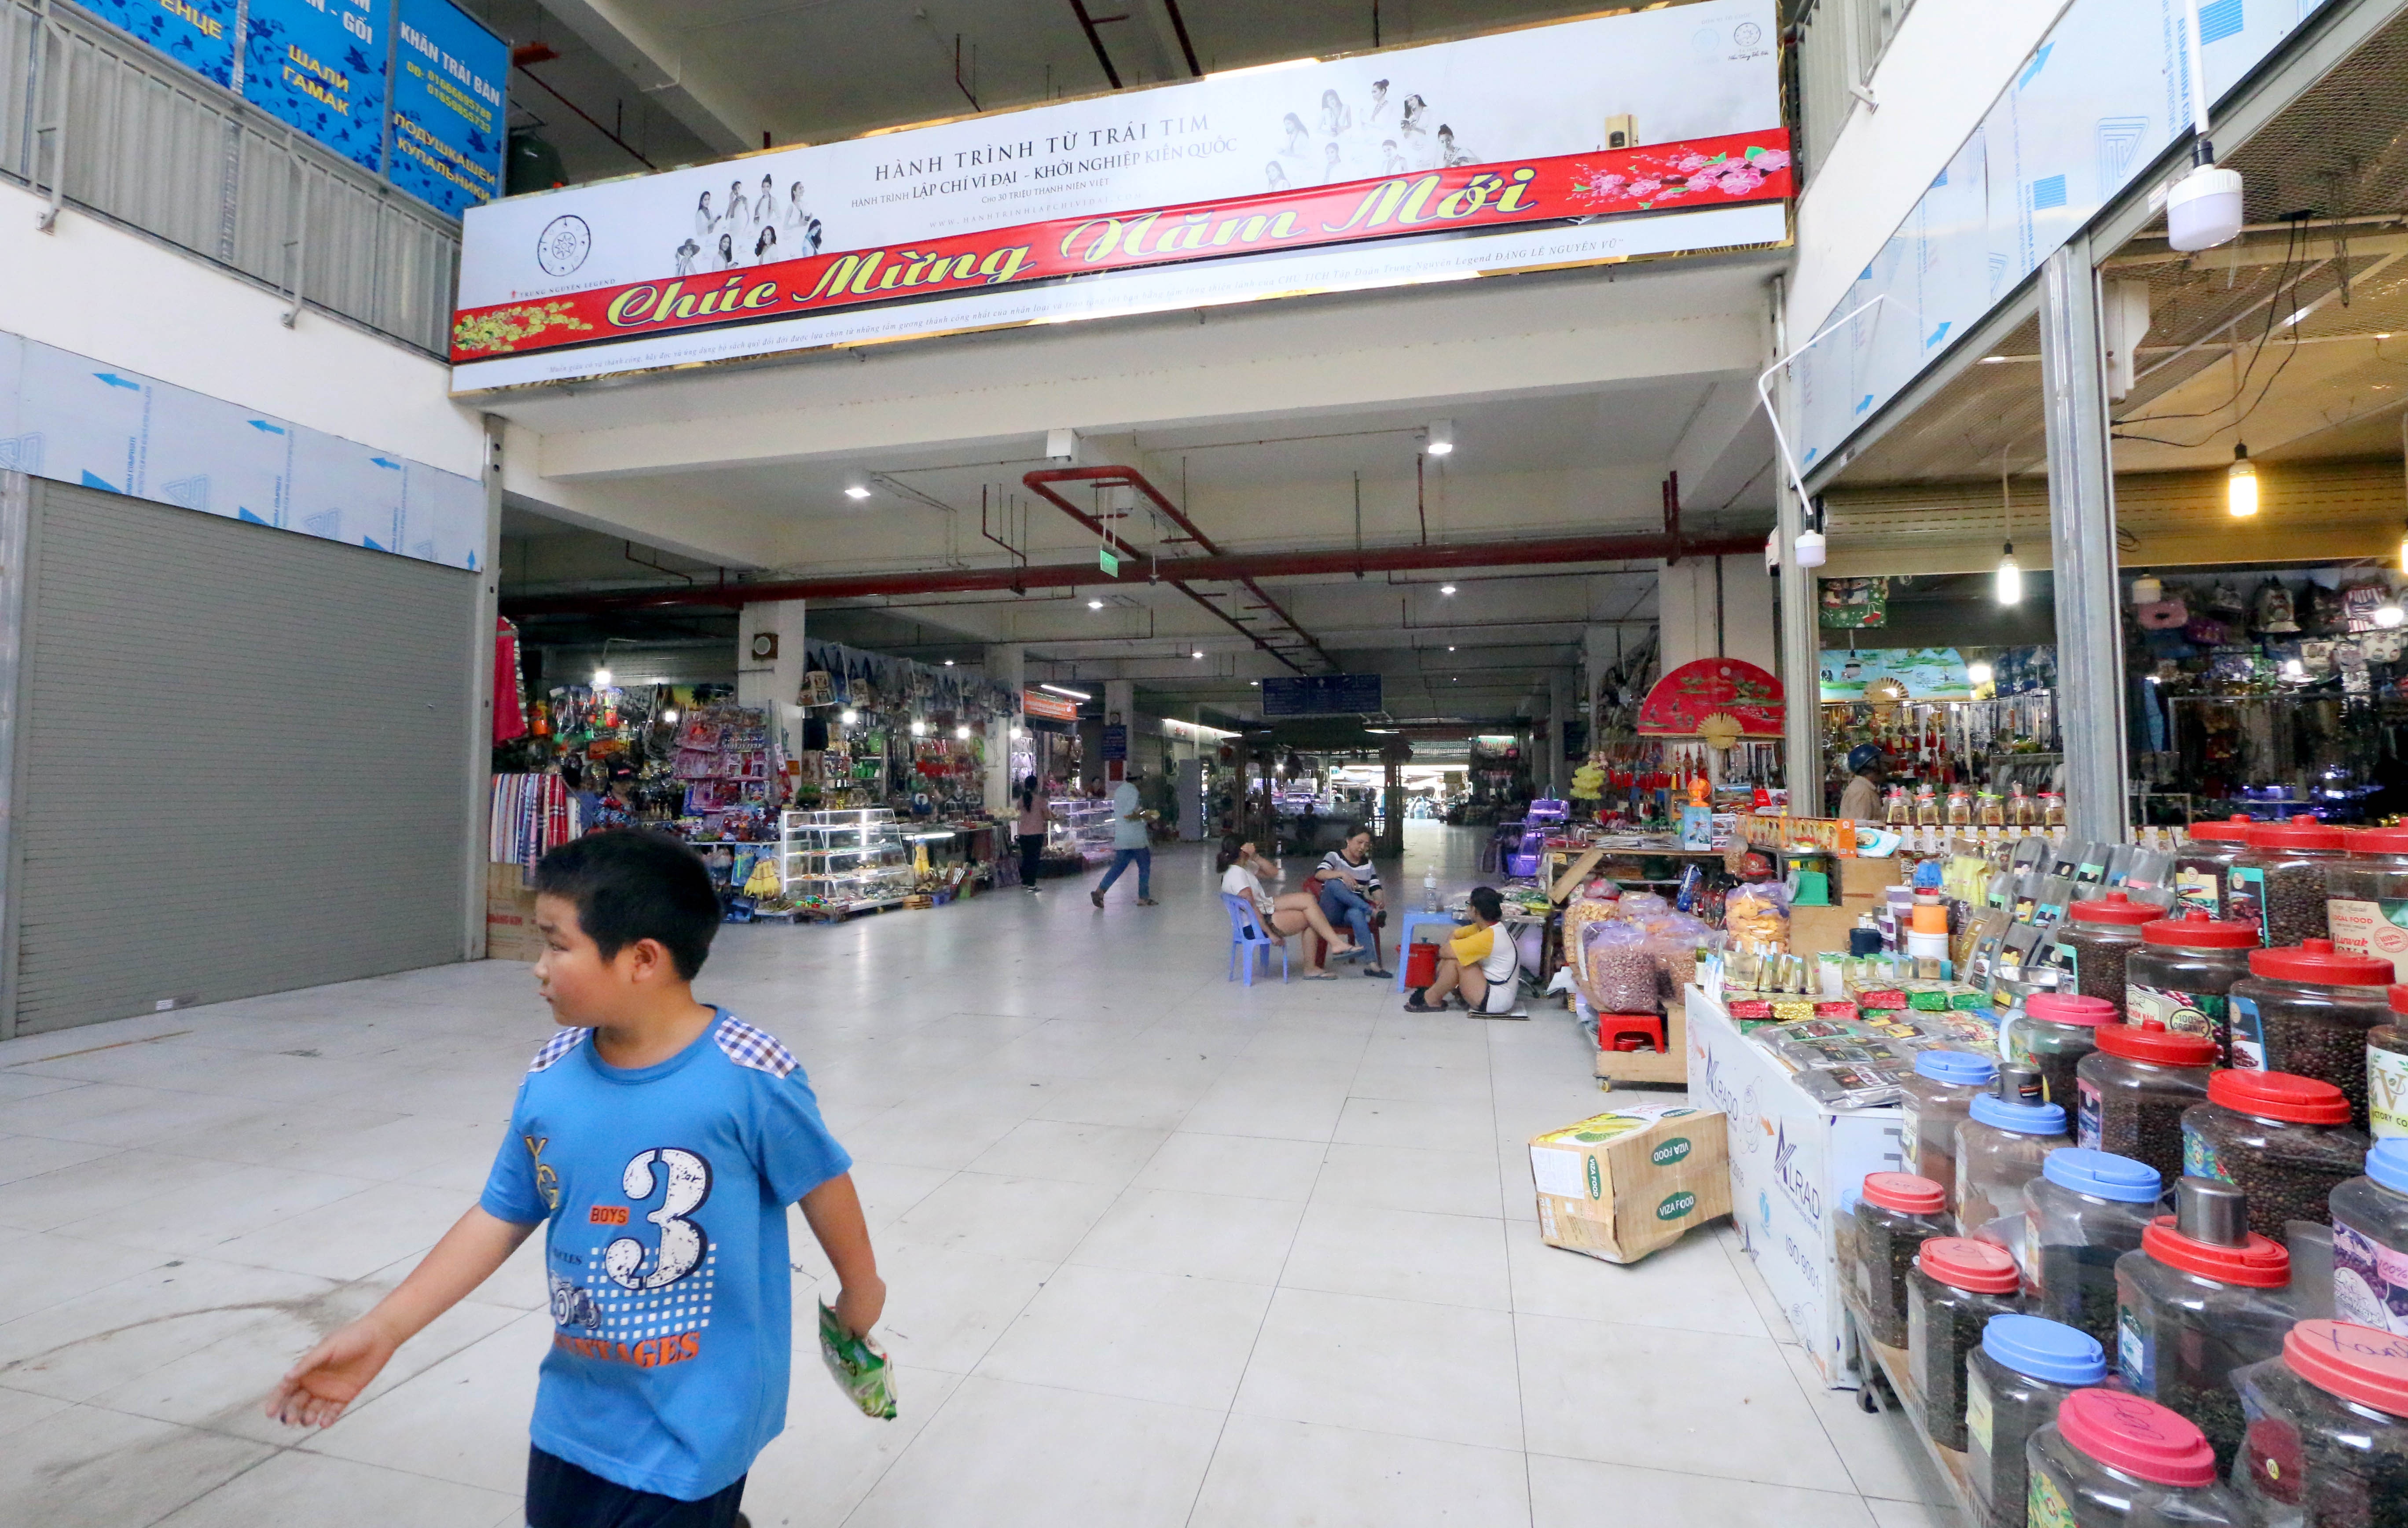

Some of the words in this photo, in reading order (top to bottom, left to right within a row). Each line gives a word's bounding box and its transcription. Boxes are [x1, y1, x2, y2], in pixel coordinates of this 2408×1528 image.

[288, 44, 349, 93] ШАЛИ
[283, 66, 349, 117] ГАМАК
[874, 156, 943, 181] HÀNH
[954, 141, 1033, 169] TRÌNH
[1045, 130, 1078, 154] TỪ
[1088, 121, 1147, 147] TRÁI
[1160, 114, 1211, 136] TIM
[851, 195, 878, 208] HÀNH
[880, 191, 910, 204] TRÌNH
[912, 182, 936, 200] LẬP
[940, 175, 969, 194] CHÍ
[971, 173, 987, 189] VĨ
[990, 170, 1018, 187] ĐẠI
[1034, 159, 1074, 179] KHỞI
[1077, 151, 1141, 173] NGHIỆP
[1145, 143, 1183, 164] KIẾN
[1187, 134, 1238, 158] QUỐC
[1009, 189, 1032, 200] TRIỆU
[1034, 185, 1063, 196] THANH
[1065, 181, 1087, 191] NIÊN
[1089, 177, 1109, 188] VIỆT
[607, 274, 780, 327] Chúc
[793, 243, 1036, 304] Mừng
[1057, 209, 1306, 265] Năm
[1322, 165, 1540, 234] Mới
[584, 279, 616, 288] LEGEND
[729, 341, 745, 350] sách
[826, 329, 844, 338] chọn
[926, 315, 948, 326] thành
[951, 313, 970, 323] công
[1011, 305, 1031, 315] nhân
[1383, 262, 1412, 273] Trung
[1455, 253, 1492, 266] Legend
[1530, 245, 1545, 257] LÊ
[1549, 239, 1597, 254] NGUYÊN
[2173, 1022, 2206, 1034] ORGANIC
[1653, 1147, 1674, 1162] FOOD
[1674, 1142, 1689, 1154] VIZA
[591, 1207, 628, 1223] BOYS
[604, 1147, 714, 1290] 3
[1659, 1204, 1676, 1216] VIZA
[1676, 1196, 1694, 1210] FOOD
